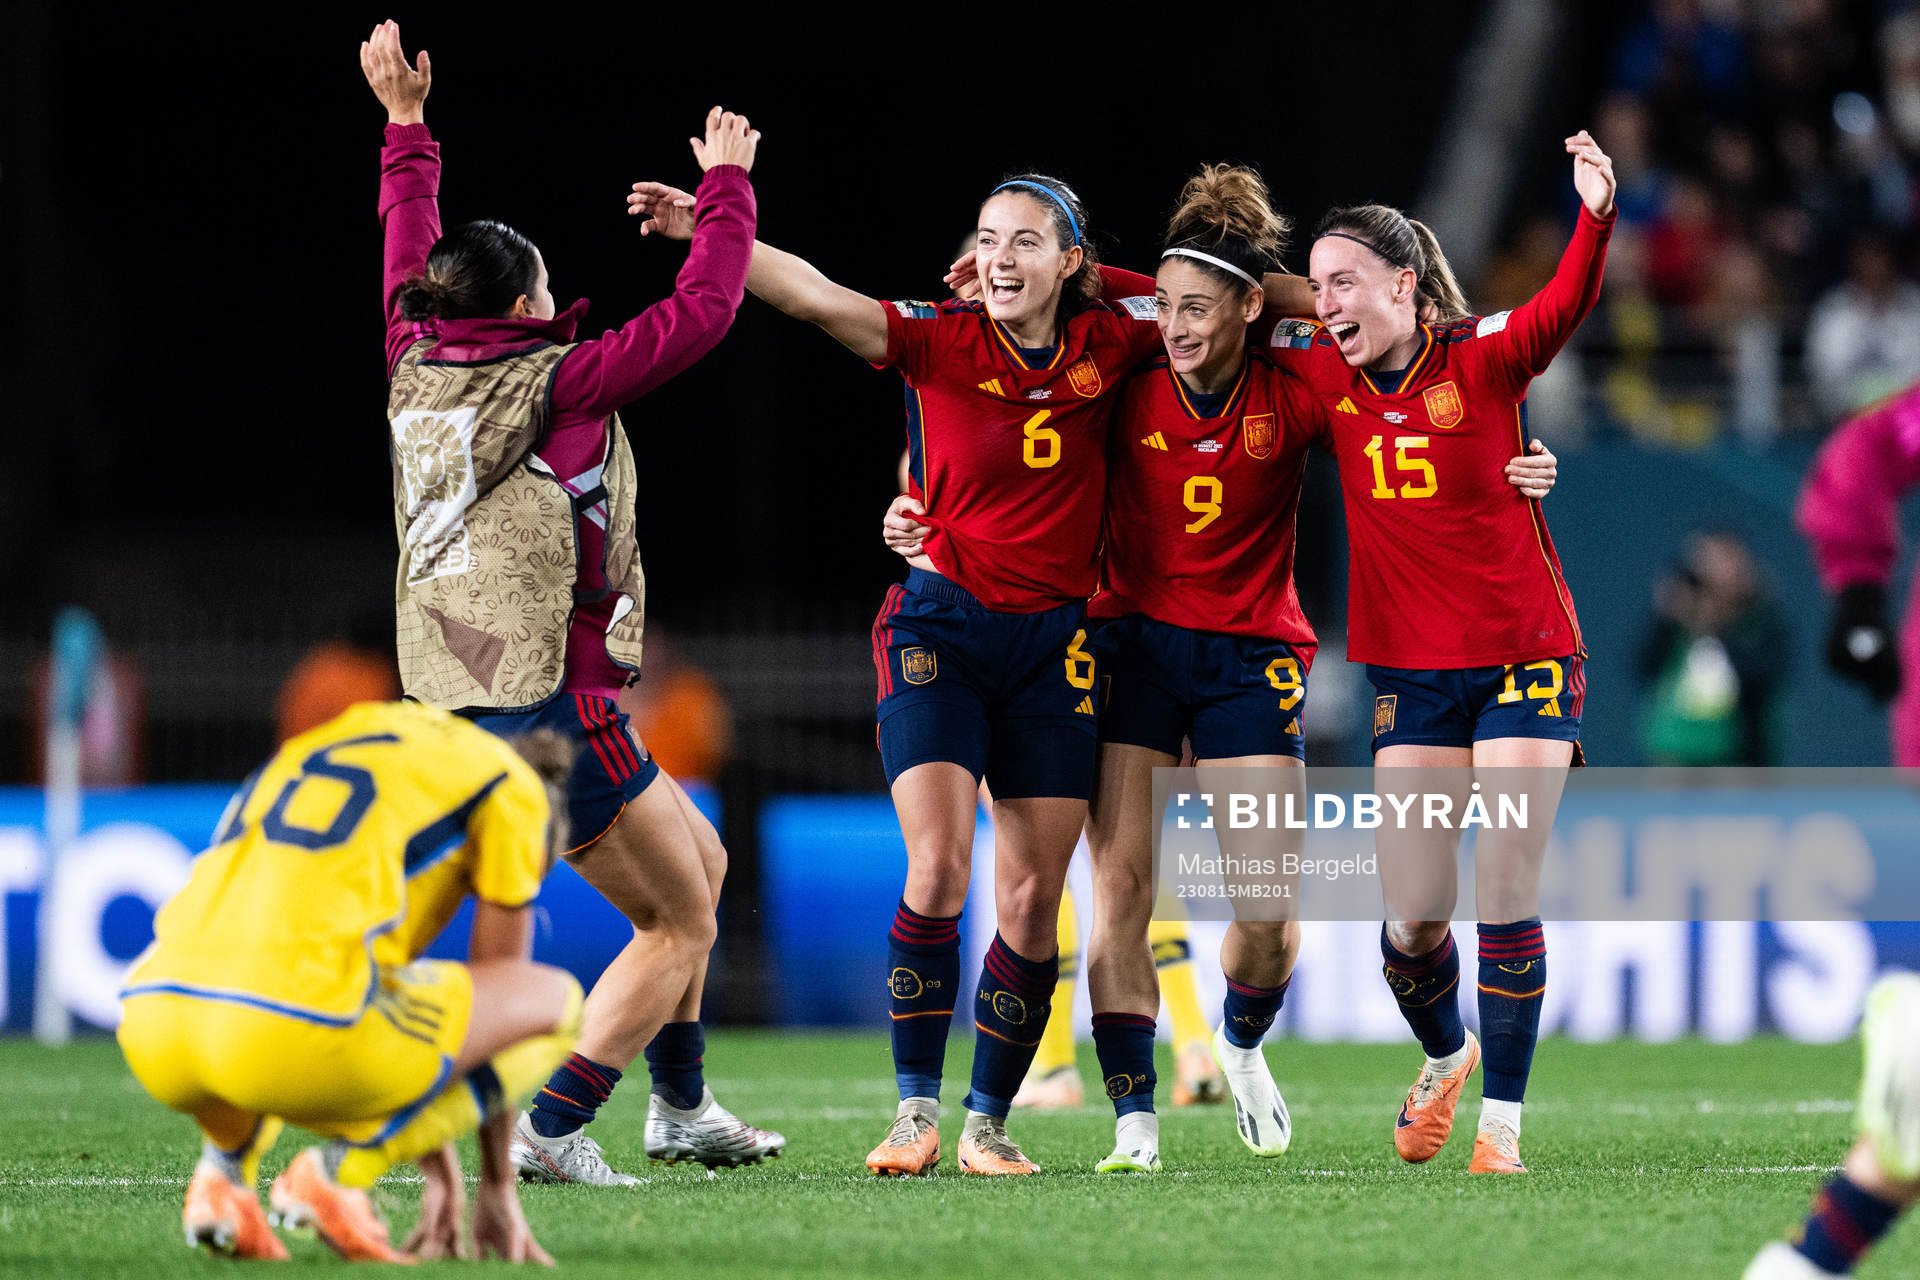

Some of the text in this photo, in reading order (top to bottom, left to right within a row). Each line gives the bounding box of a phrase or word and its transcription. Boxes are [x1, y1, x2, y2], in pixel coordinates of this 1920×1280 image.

[1022, 410, 1061, 468] 6
[1363, 435, 1438, 499] 15
[1183, 475, 1223, 534] 9
[1065, 629, 1096, 690] 6
[1265, 657, 1304, 711] 9
